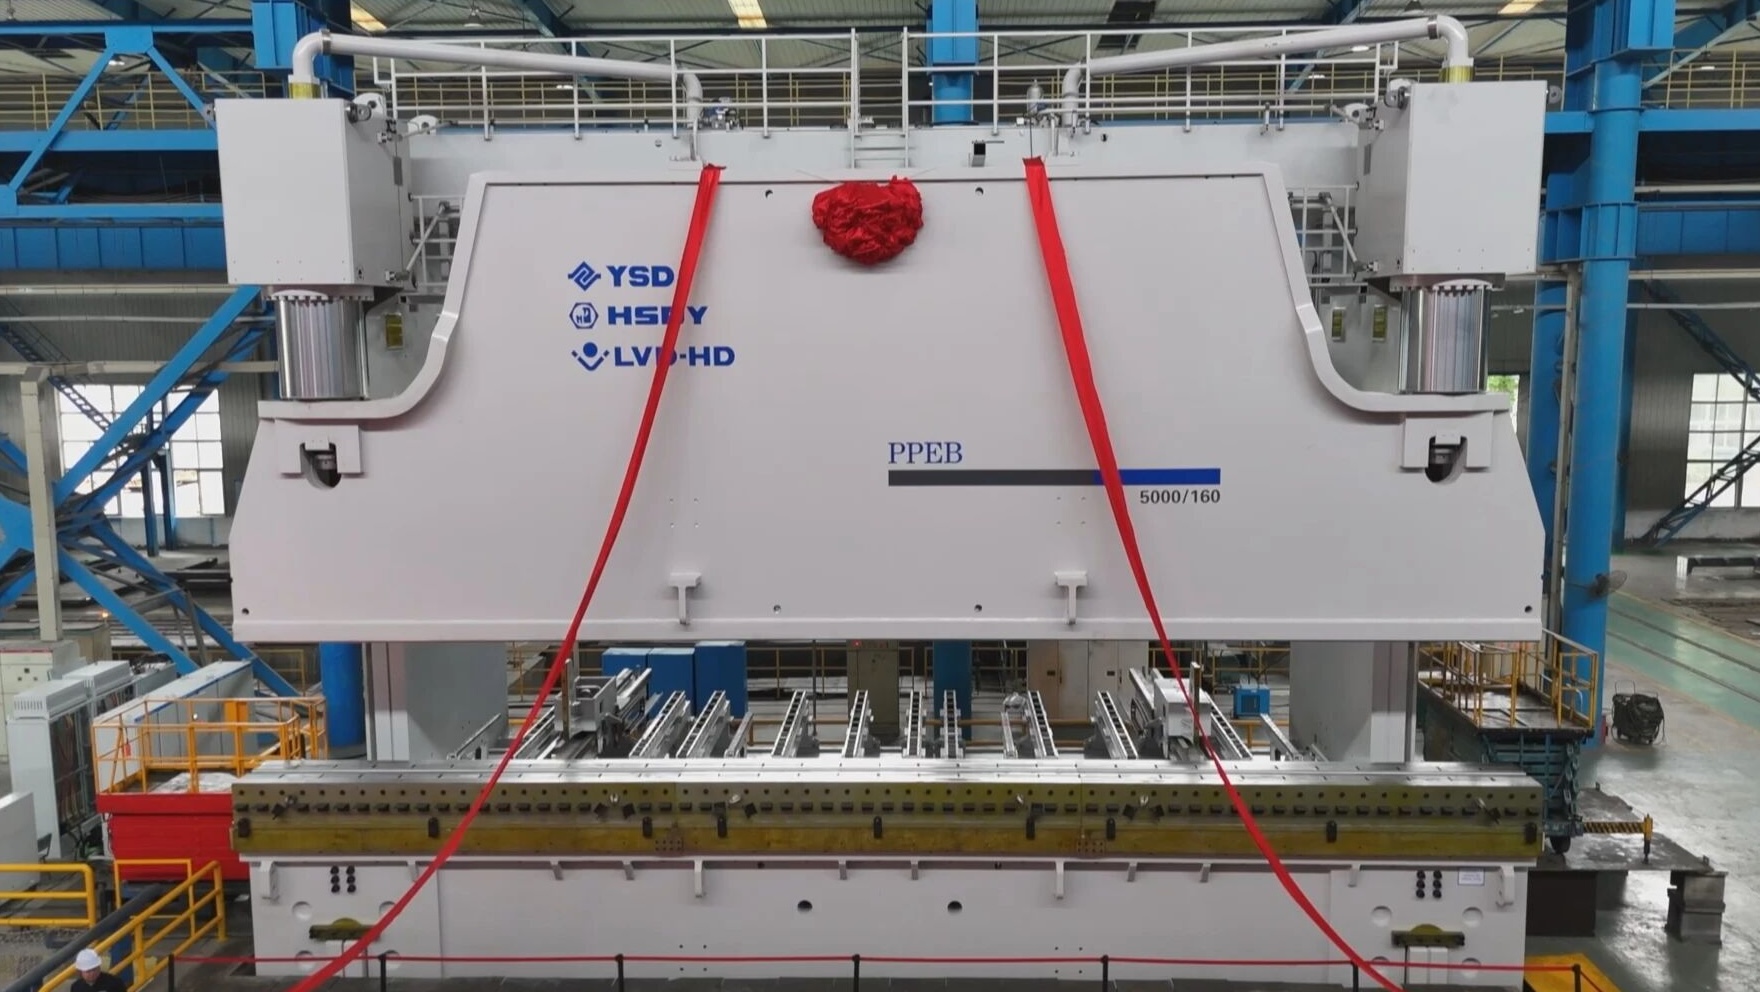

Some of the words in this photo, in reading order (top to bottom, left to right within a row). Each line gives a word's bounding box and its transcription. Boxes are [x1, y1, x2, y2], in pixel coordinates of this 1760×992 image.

[606, 265, 675, 287] YSD
[888, 441, 963, 465] PPEB
[1139, 489, 1221, 505] 5000/160
